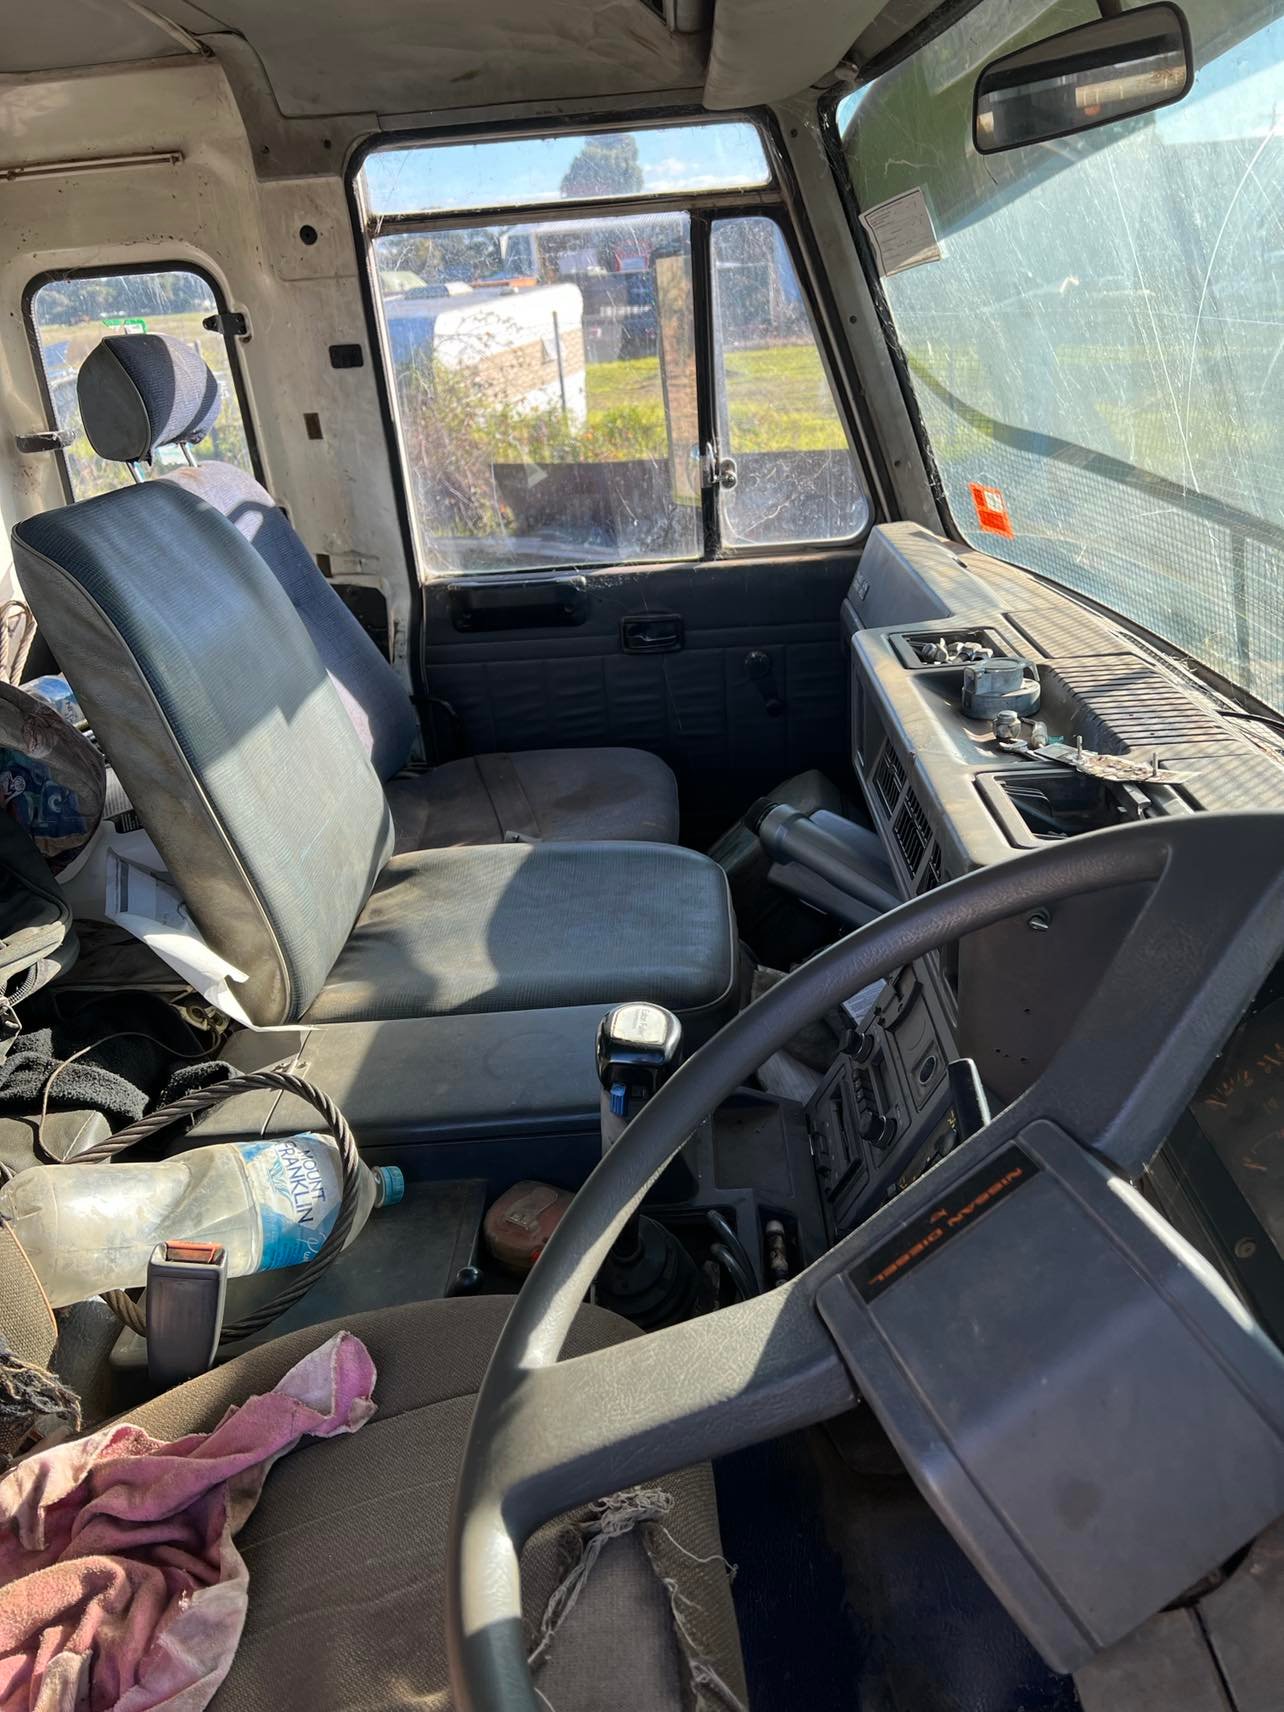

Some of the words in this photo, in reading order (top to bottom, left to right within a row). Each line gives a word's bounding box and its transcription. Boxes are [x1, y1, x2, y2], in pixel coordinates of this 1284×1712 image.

[278, 1140, 314, 1224] FRANKLIN
[302, 1149, 326, 1202] MOUNT
[948, 1168, 1023, 1227] NISSAN
[867, 1228, 944, 1286] DIESEL
